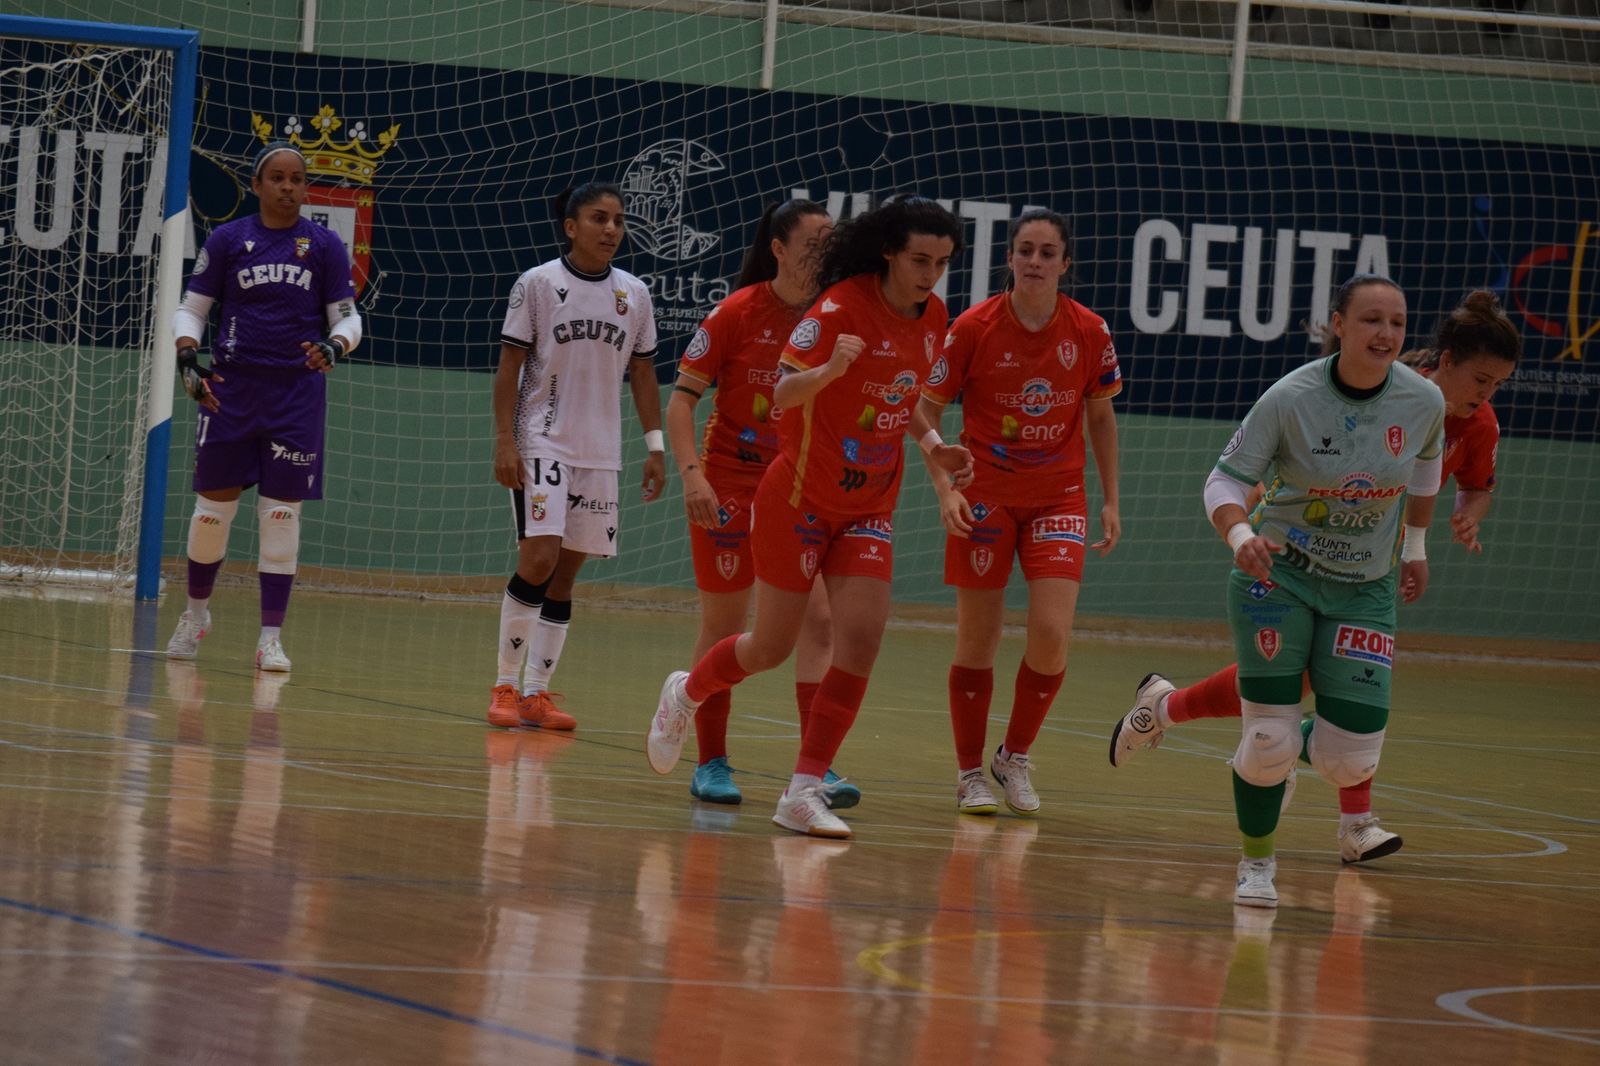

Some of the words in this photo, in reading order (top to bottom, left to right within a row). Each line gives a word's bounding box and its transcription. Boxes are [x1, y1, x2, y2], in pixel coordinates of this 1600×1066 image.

[0, 125, 196, 259] UTA
[237, 263, 312, 291] CEUTA
[553, 319, 627, 351] CEUTA
[549, 374, 558, 410] ALMINA
[994, 389, 1077, 408] PESCAMAR
[534, 458, 561, 486] 13
[1034, 517, 1084, 537] FROIZ
[1328, 511, 1384, 528] ence
[1326, 550, 1372, 562] GALICIA
[1336, 627, 1393, 658] FROIZ
